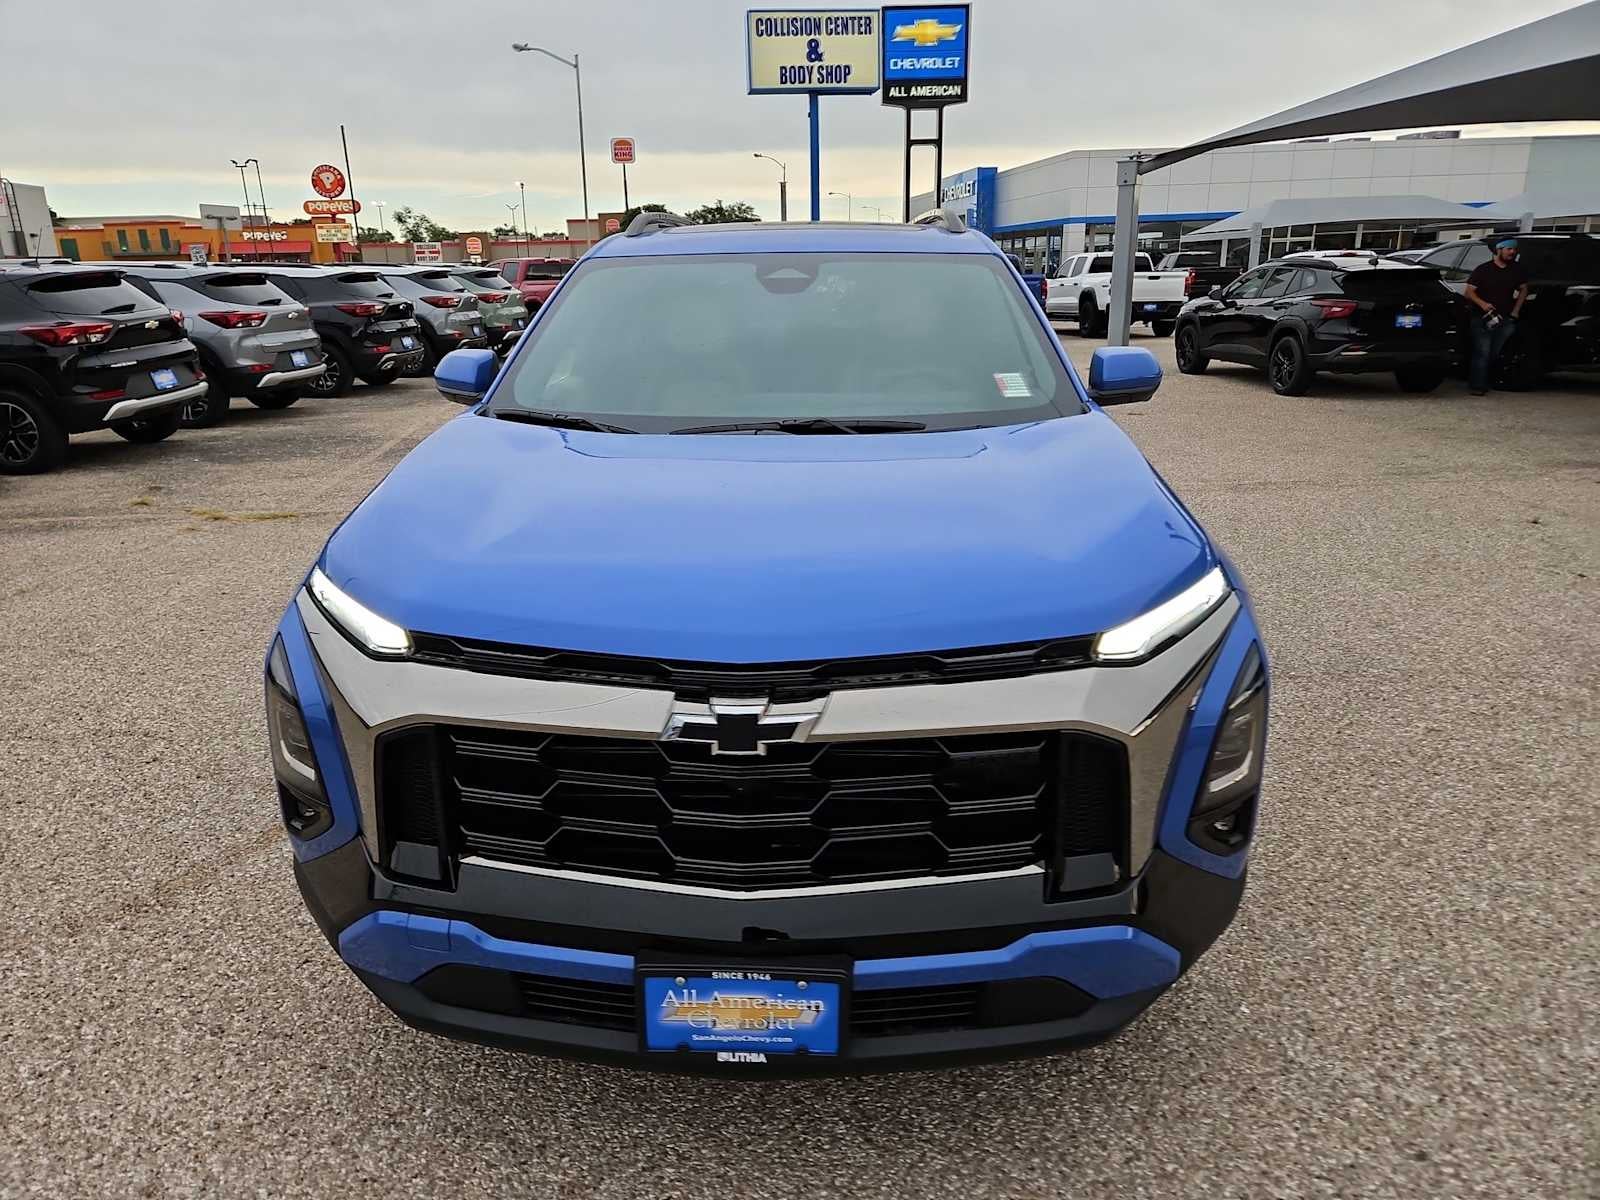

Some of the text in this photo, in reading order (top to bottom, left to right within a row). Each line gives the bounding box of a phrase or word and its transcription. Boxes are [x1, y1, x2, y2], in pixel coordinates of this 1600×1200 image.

[755, 16, 873, 38] COLLISION CENTER
[806, 38, 824, 63] &
[889, 57, 960, 70] CHEVROLET
[779, 64, 851, 85] BODY SHOP
[889, 85, 962, 98] ALL AMERICAN
[193, 254, 206, 263] 35
[712, 972, 772, 981] SINCE 1946
[660, 988, 825, 1012] All American
[687, 1009, 796, 1031] Chevrolet
[691, 1033, 793, 1043] SanAngeloChevy.com
[730, 1052, 767, 1064] LITHIA
